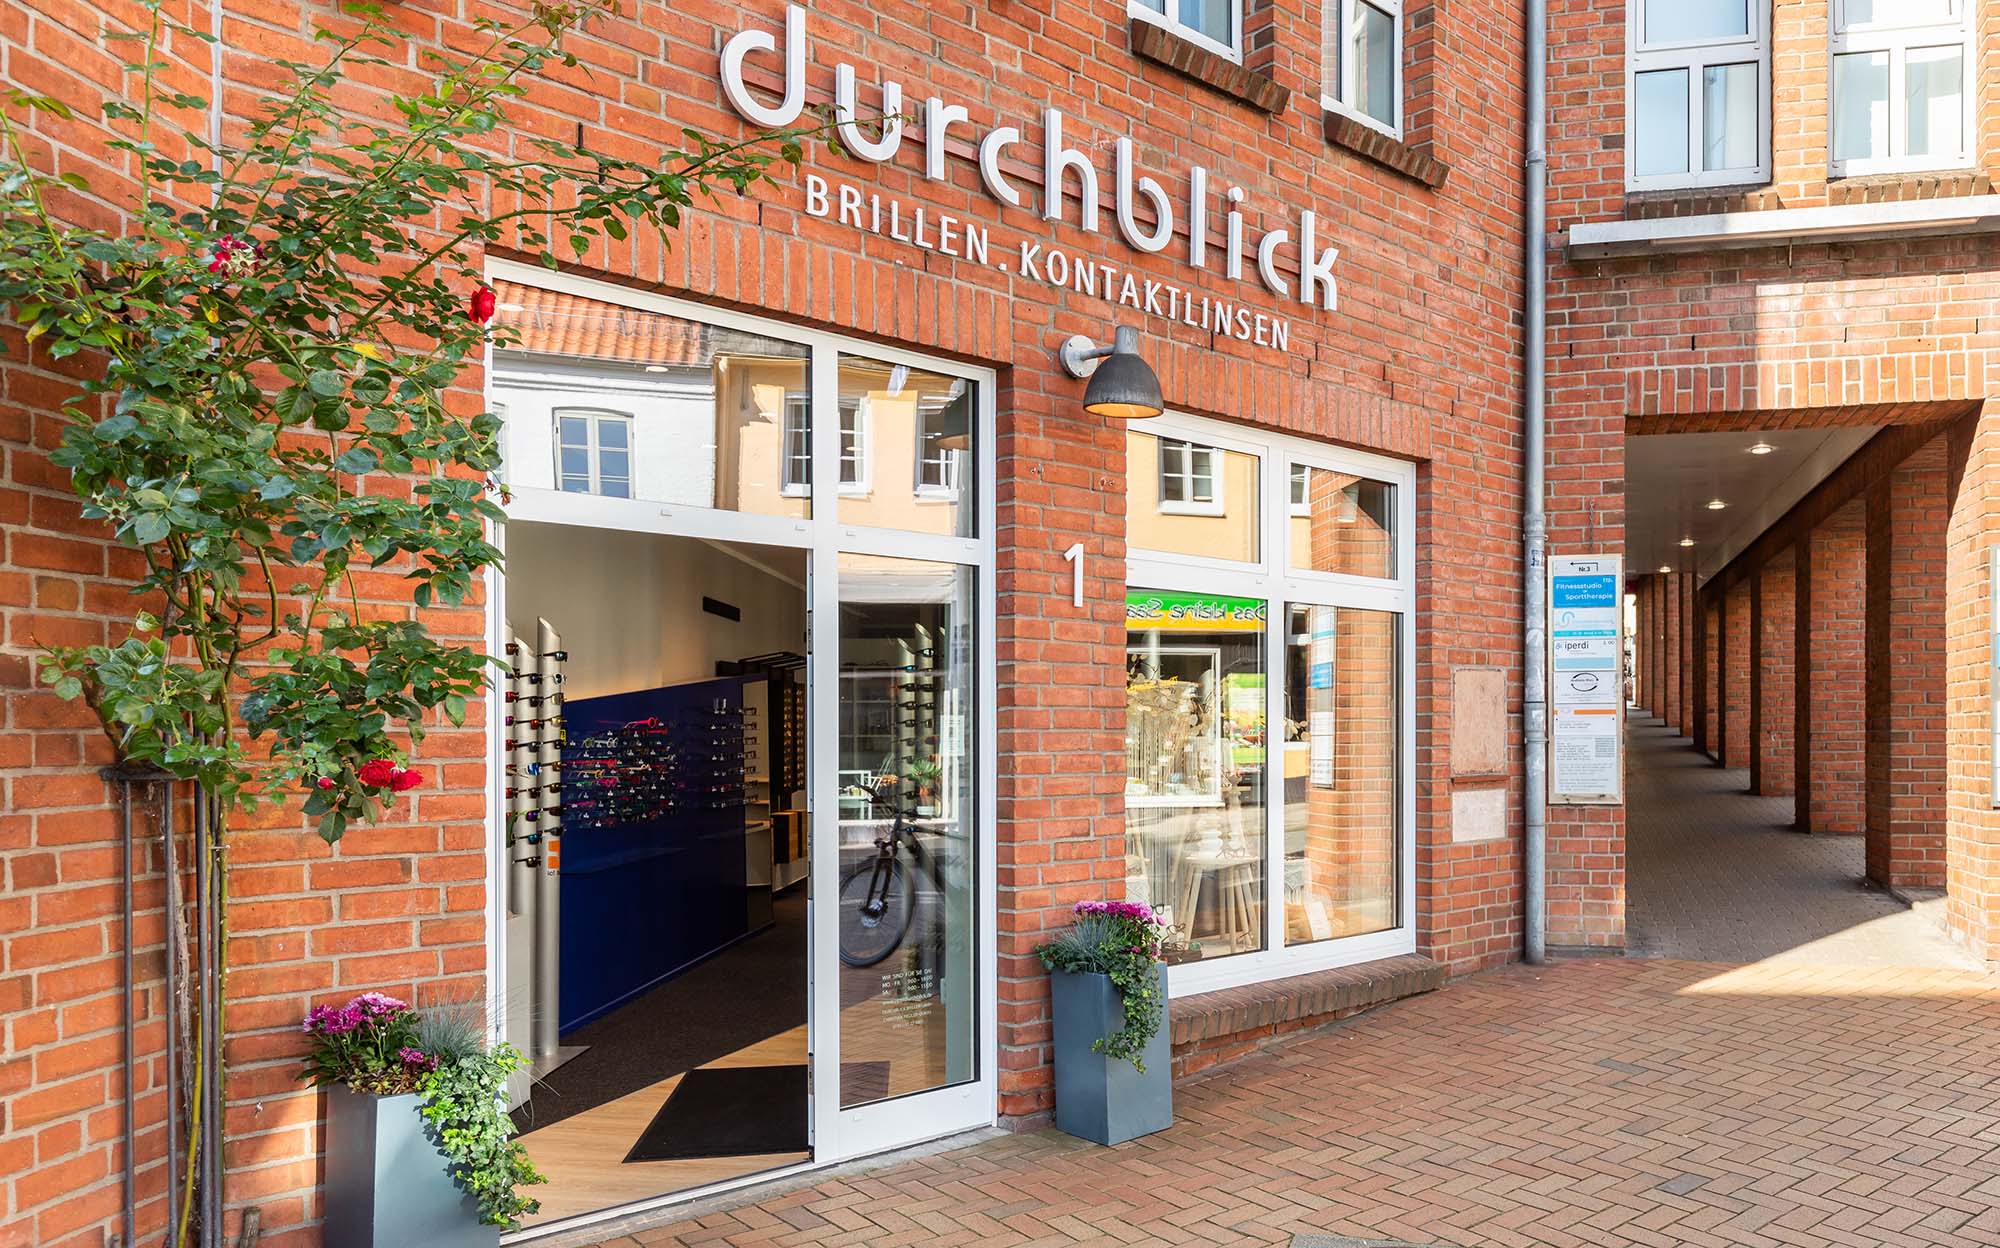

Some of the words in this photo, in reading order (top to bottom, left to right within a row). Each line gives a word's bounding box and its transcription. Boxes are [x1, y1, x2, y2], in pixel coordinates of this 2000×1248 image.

[720, 4, 1340, 311] durchblick
[1020, 240, 1288, 351] KONTAKTLINSEN
[1064, 543, 1083, 608] 1
[1565, 592, 1613, 600] Sporttherapie
[1564, 640, 1589, 652] iperdi
